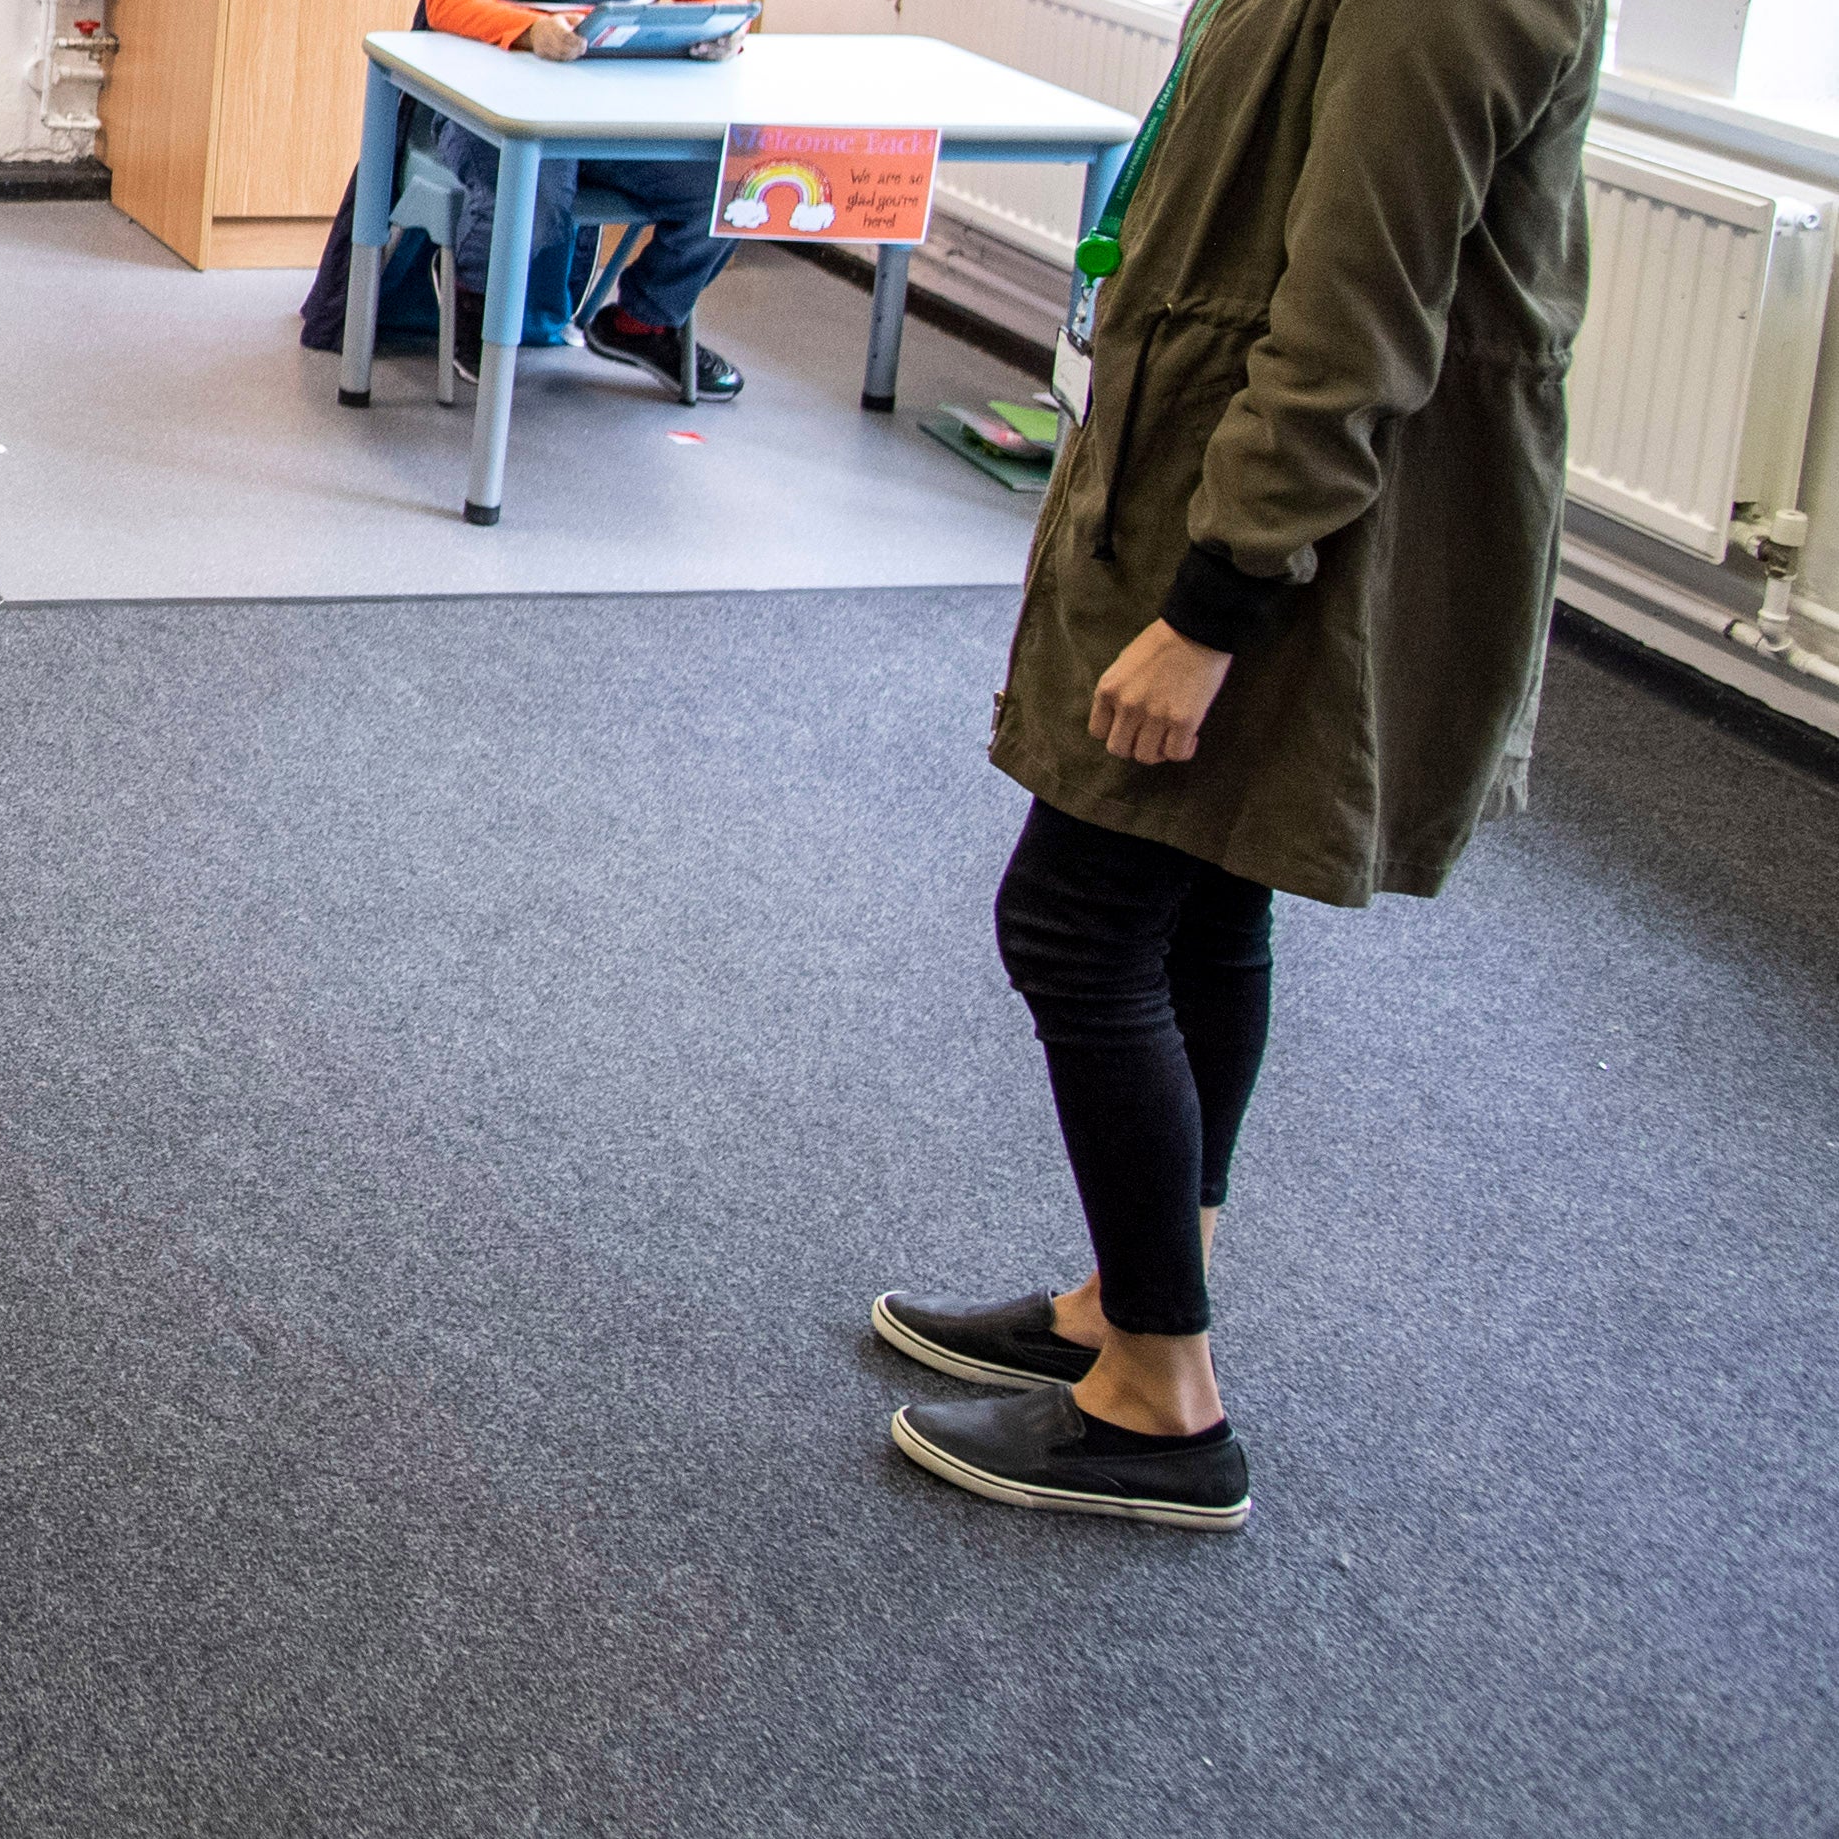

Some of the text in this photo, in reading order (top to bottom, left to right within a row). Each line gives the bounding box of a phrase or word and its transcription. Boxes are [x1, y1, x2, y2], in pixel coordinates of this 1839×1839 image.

[850, 169, 923, 184] We are so
[847, 192, 875, 210] glad
